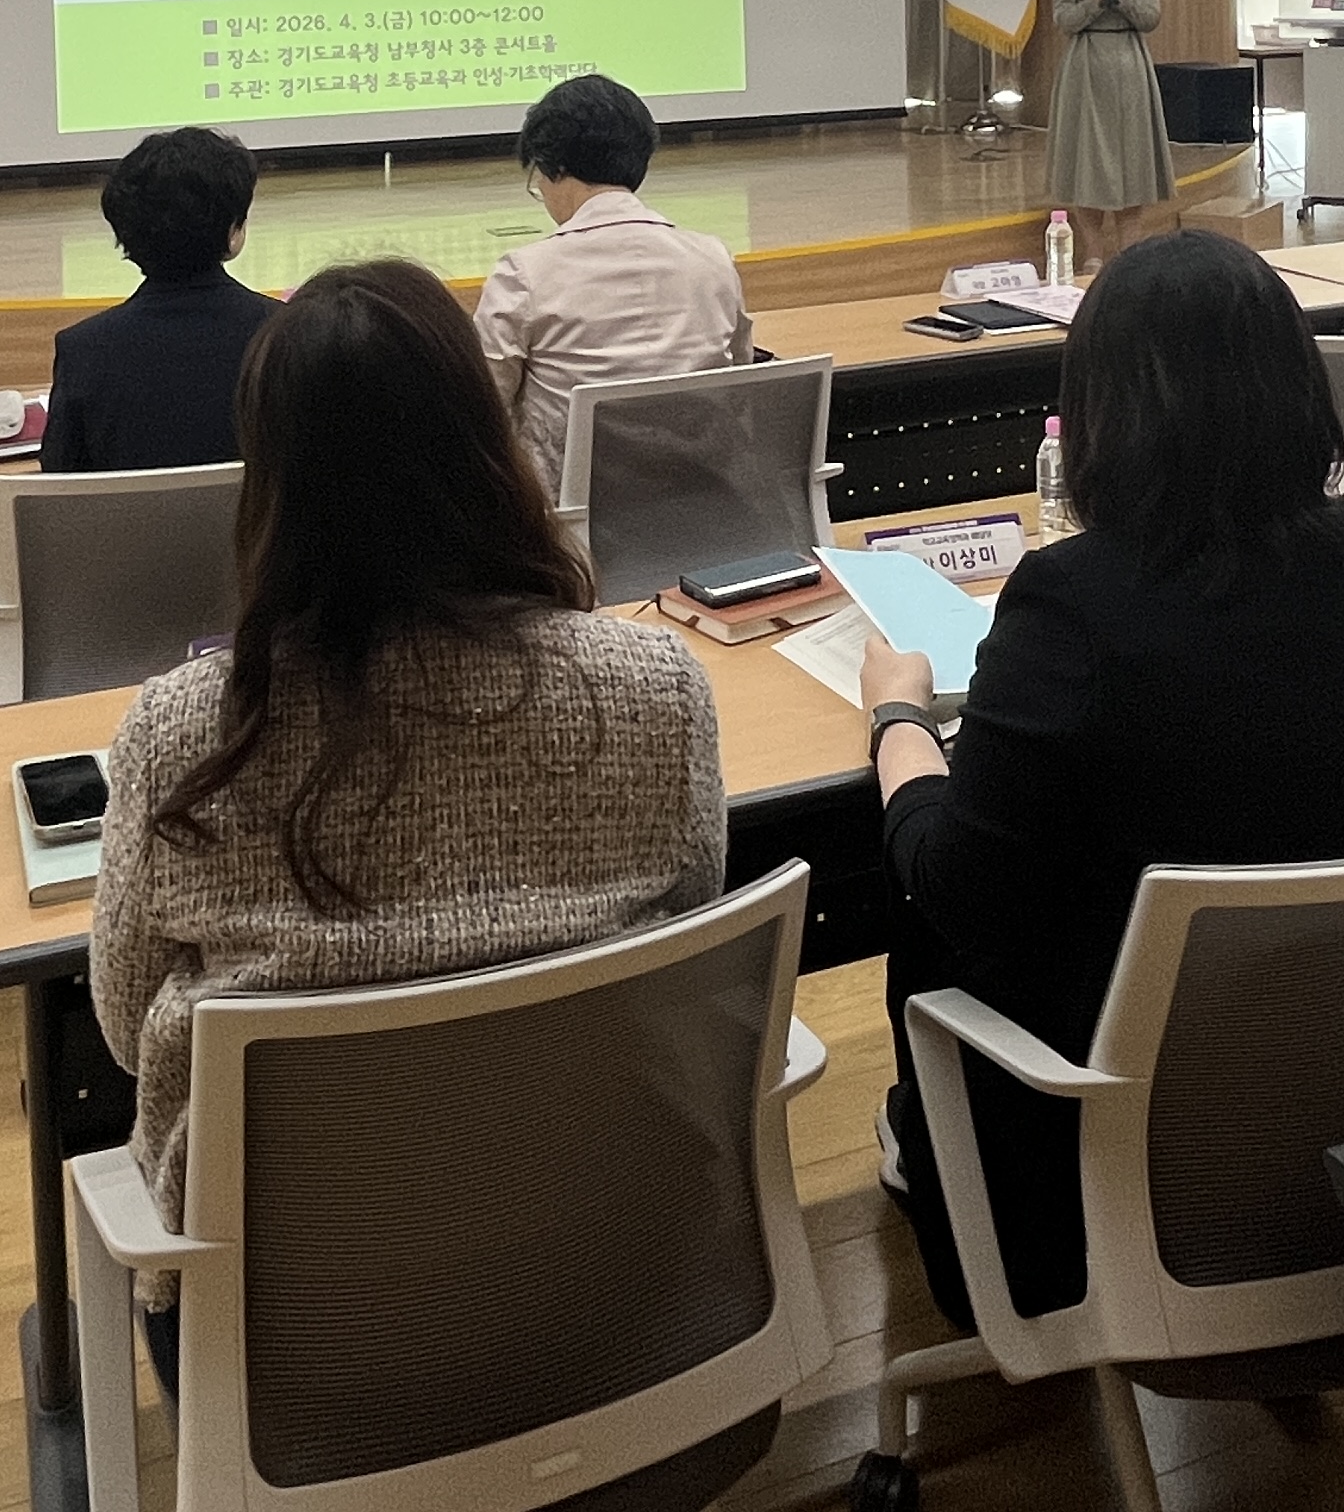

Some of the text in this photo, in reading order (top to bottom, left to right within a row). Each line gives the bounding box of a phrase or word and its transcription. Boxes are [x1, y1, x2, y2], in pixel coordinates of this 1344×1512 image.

[226, 5, 544, 38] 일시: 2026. 4. 3.(금) 10:00~12:00
[226, 34, 558, 70] 장소: 경기도교육청 남부청사 3층 콘서트홀
[228, 79, 270, 100] 주관:
[278, 72, 379, 99] 경기도교육청
[384, 68, 467, 92] 초등교육과
[939, 544, 998, 571] 이상미
